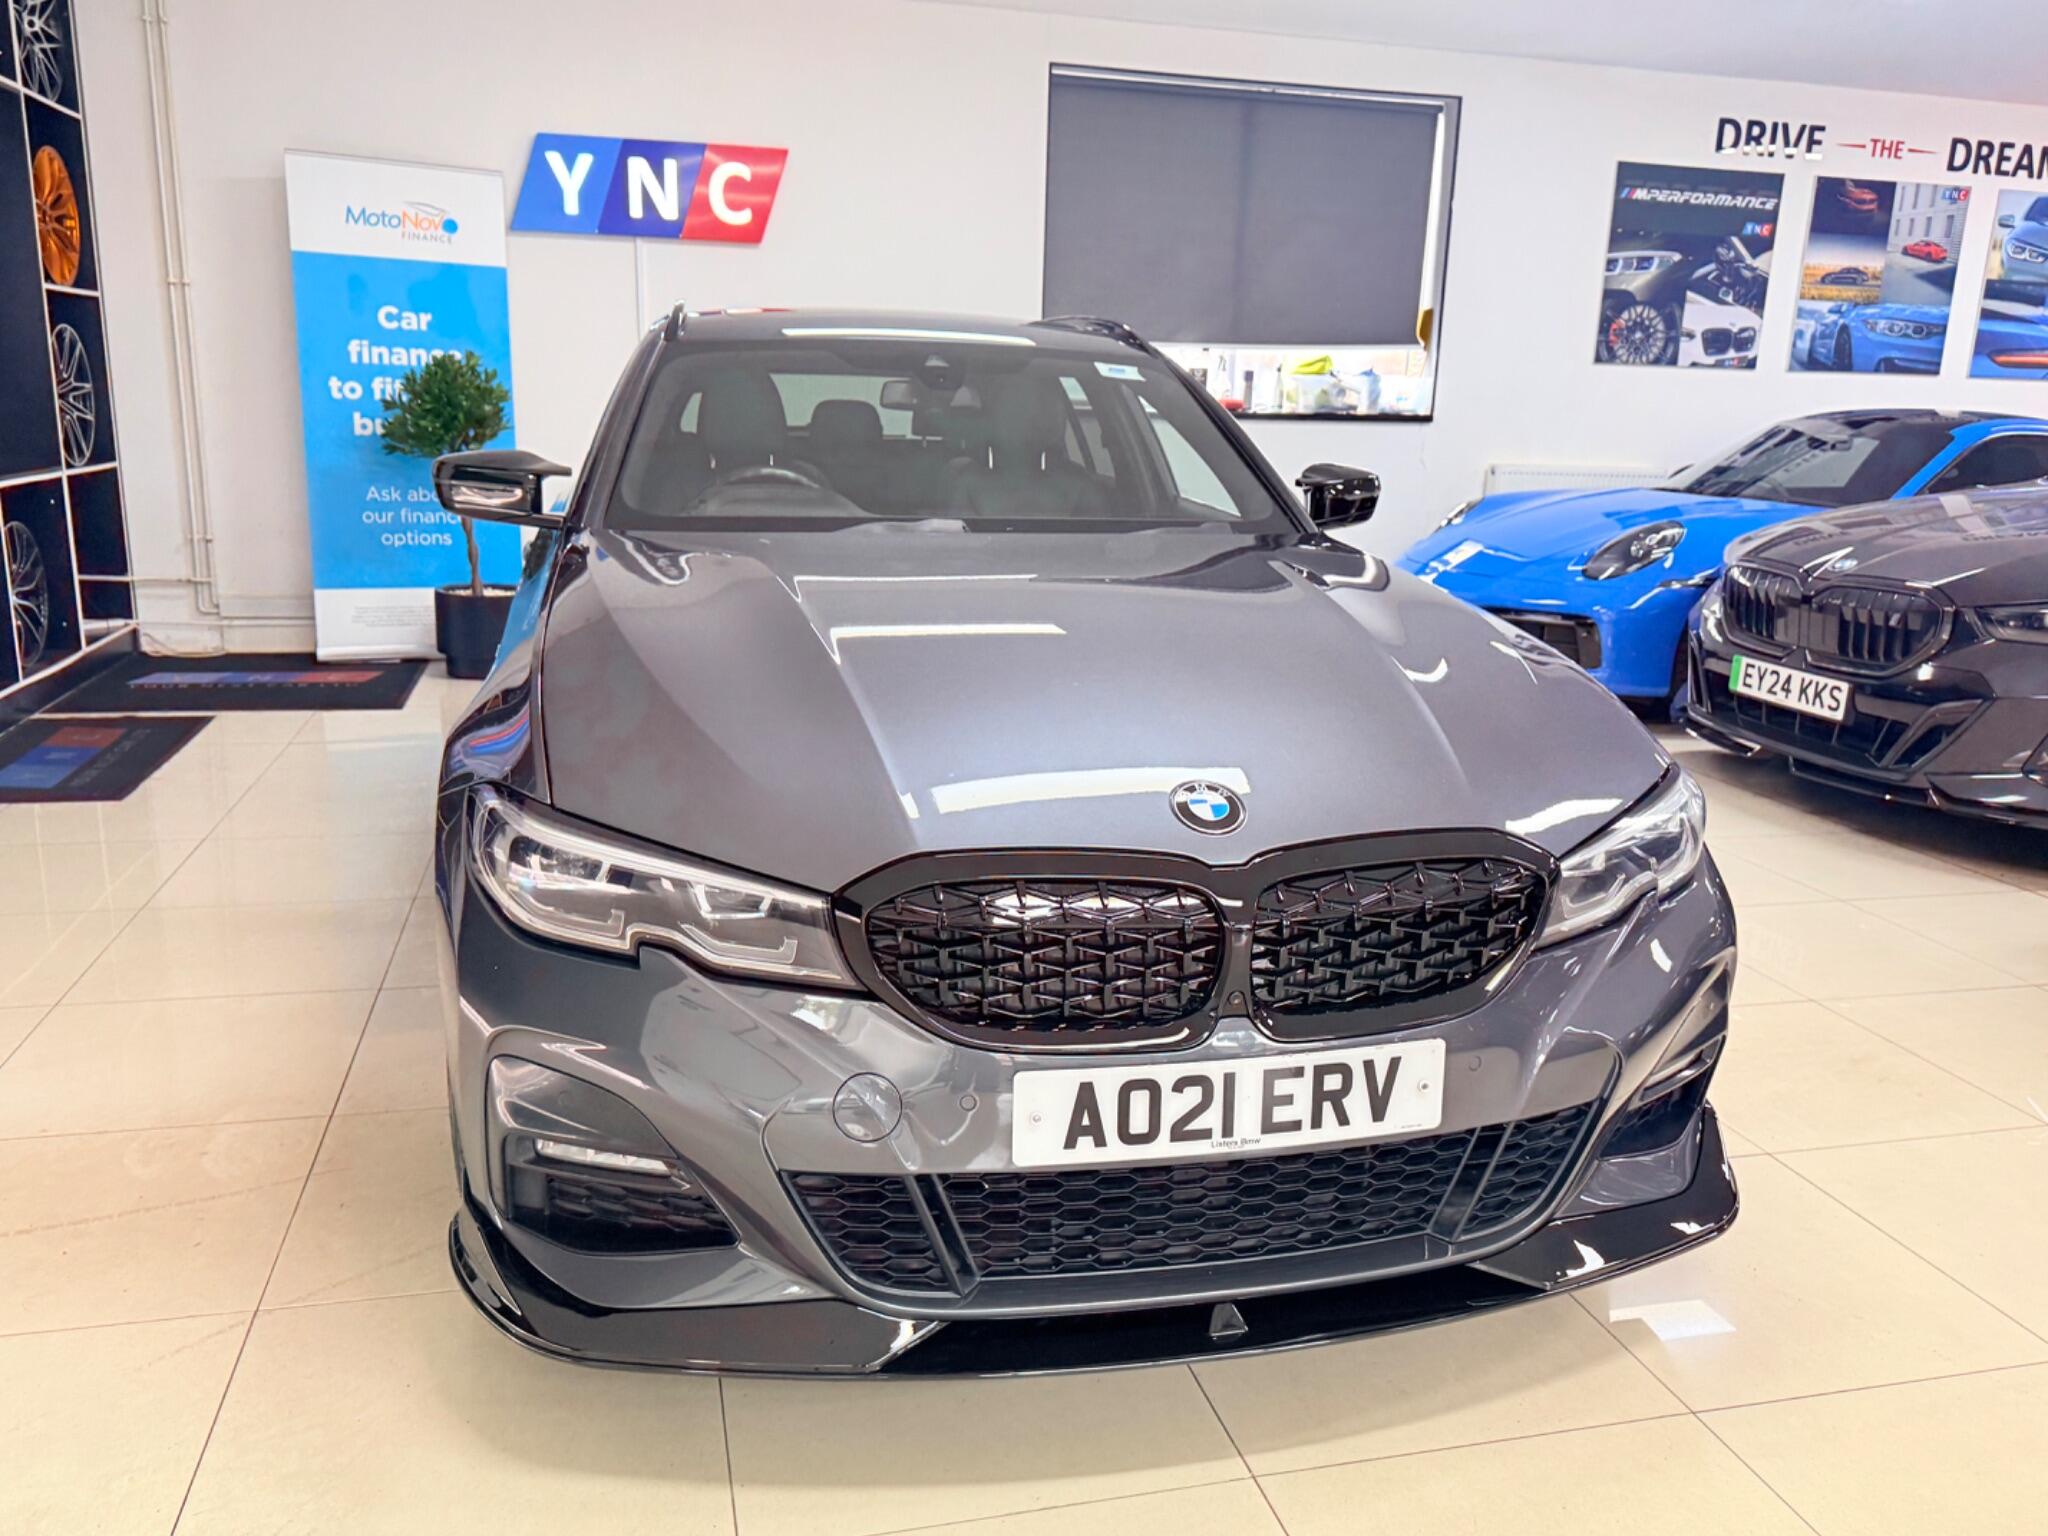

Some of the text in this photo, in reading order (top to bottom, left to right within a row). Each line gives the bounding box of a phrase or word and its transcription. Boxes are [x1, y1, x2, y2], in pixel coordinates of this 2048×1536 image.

[1715, 117, 1826, 160] DRIVE
[1870, 138, 1905, 159] THE
[544, 150, 752, 225] YNC
[401, 231, 453, 245] FINANCE
[376, 304, 433, 331] Car
[328, 376, 363, 401] to
[366, 485, 402, 502] Ask
[362, 507, 462, 525] our financ
[381, 529, 453, 548] options
[1742, 663, 1843, 712] EY24 KKS
[1260, 1056, 1402, 1135] ERV
